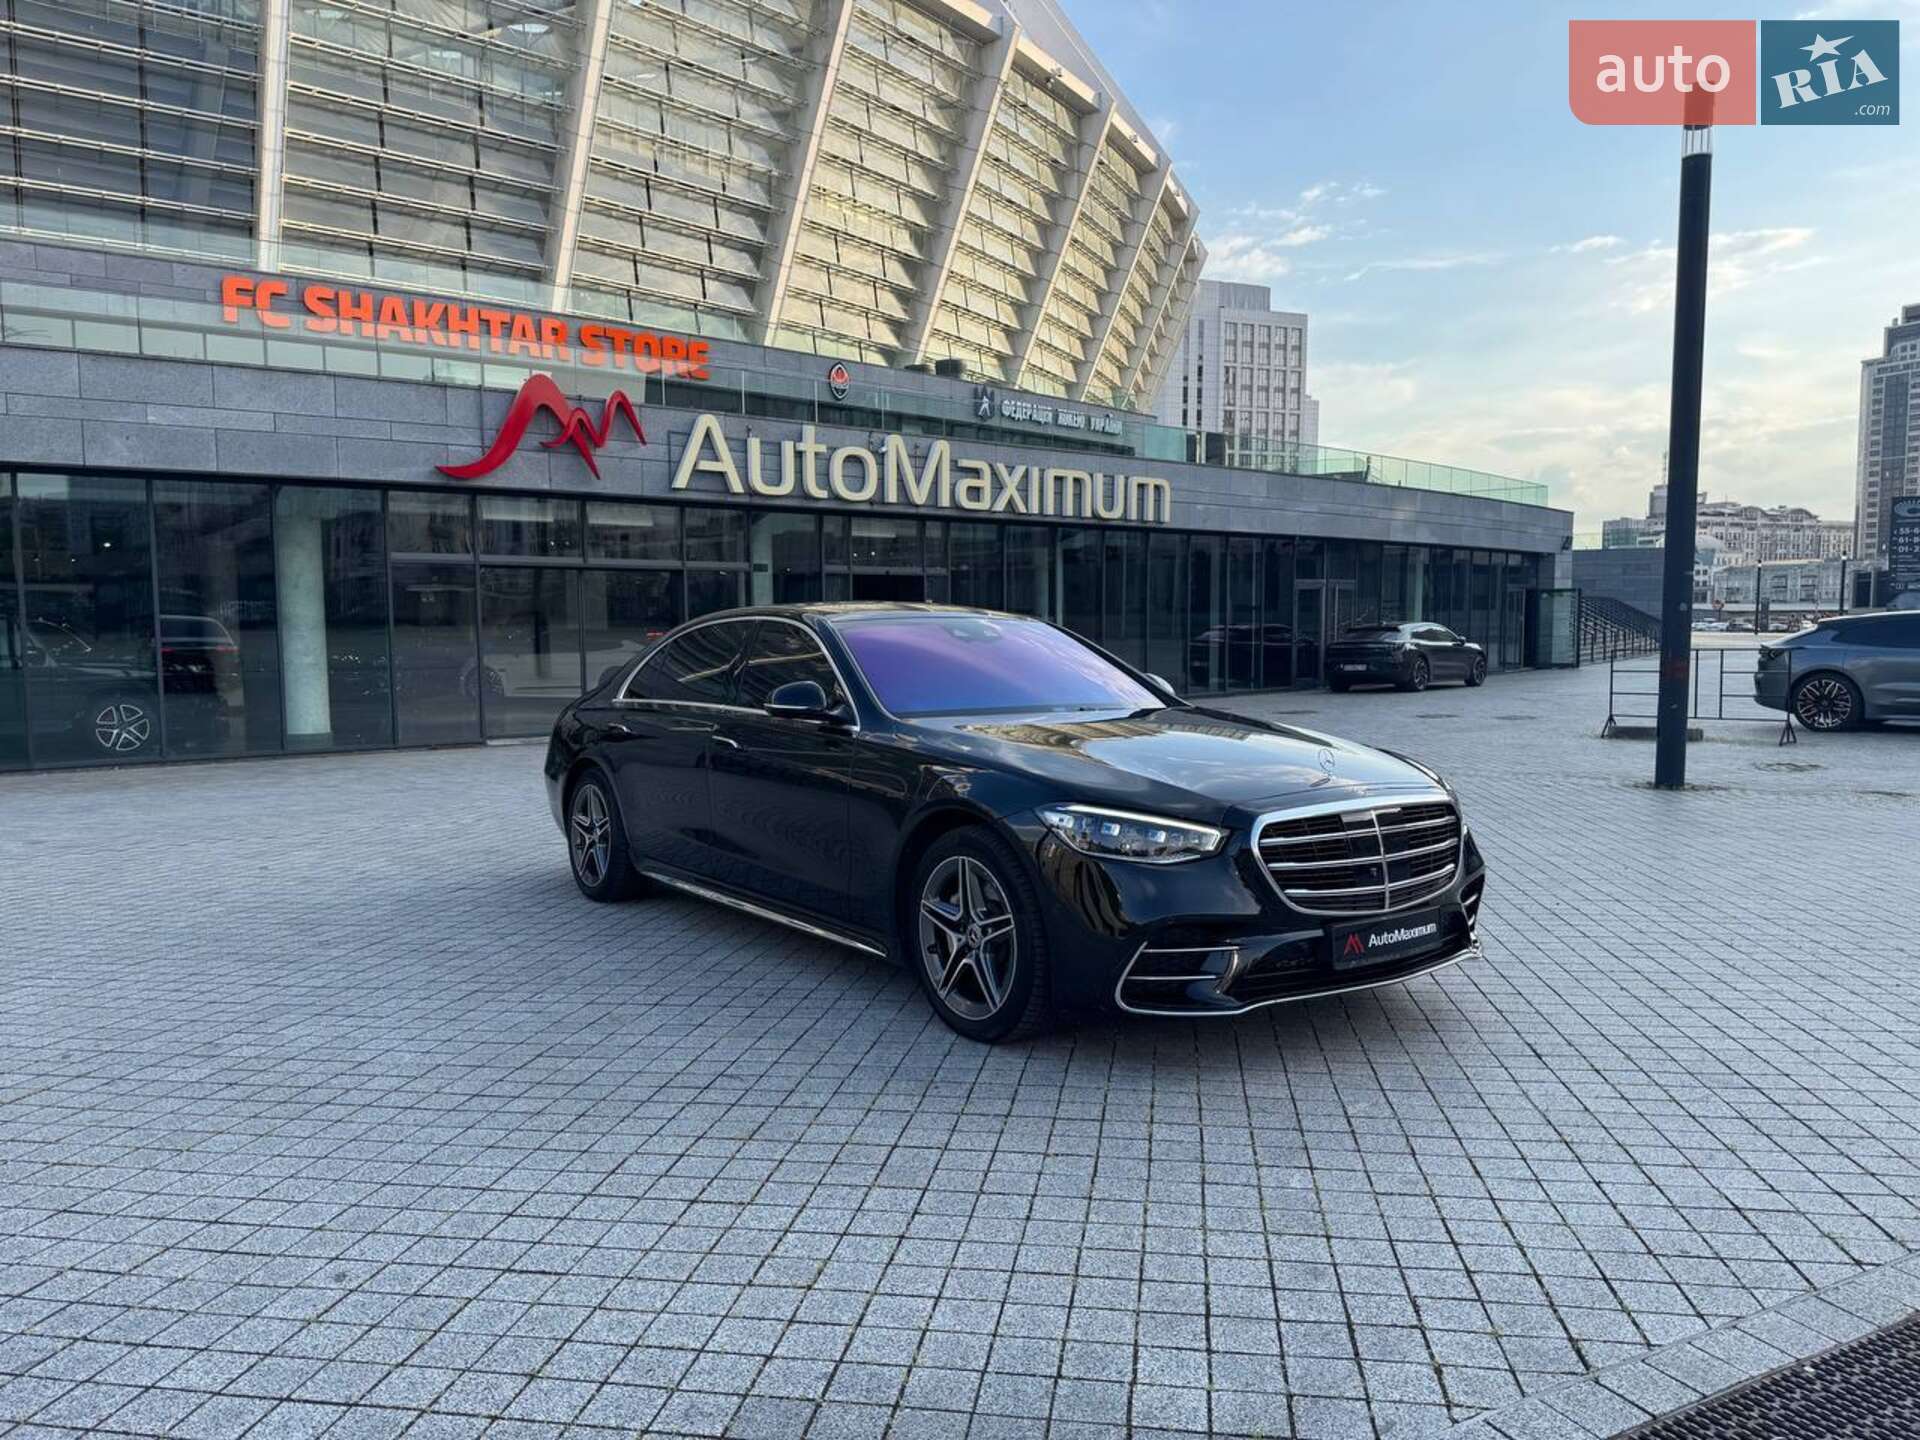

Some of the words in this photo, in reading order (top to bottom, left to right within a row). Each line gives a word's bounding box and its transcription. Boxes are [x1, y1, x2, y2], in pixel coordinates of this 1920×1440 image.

[220, 275, 291, 329] FC
[303, 283, 571, 361] SHAKHTAR
[579, 323, 712, 380] STORE
[671, 413, 1172, 524] AutoMaximum
[1367, 922, 1437, 948] AutoMaximum
